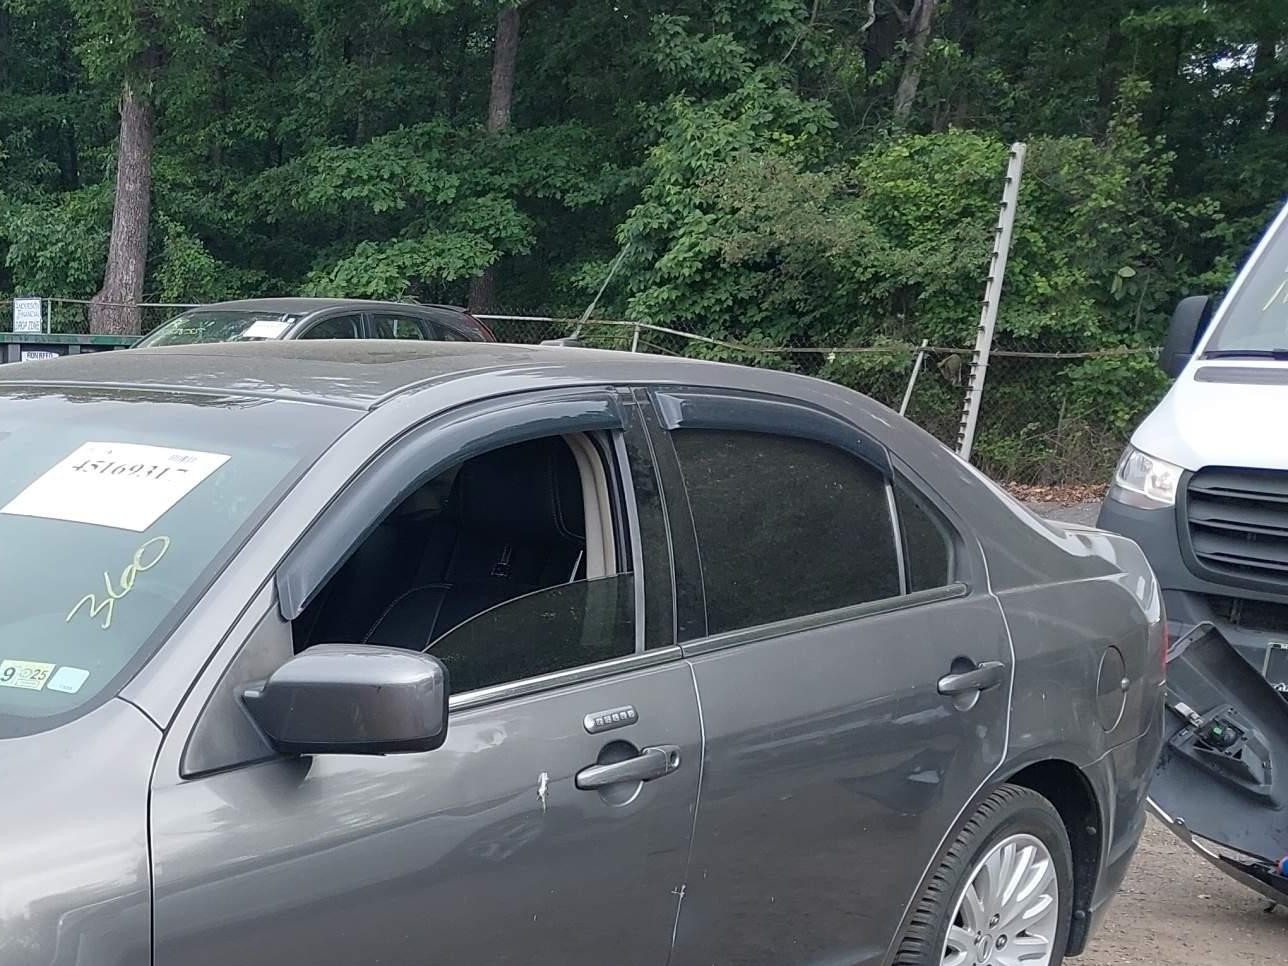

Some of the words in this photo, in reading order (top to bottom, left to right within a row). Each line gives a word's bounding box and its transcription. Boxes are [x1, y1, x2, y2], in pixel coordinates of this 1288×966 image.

[65, 535, 170, 630] 360
[0, 667, 16, 682] 9
[30, 669, 48, 681] 25
